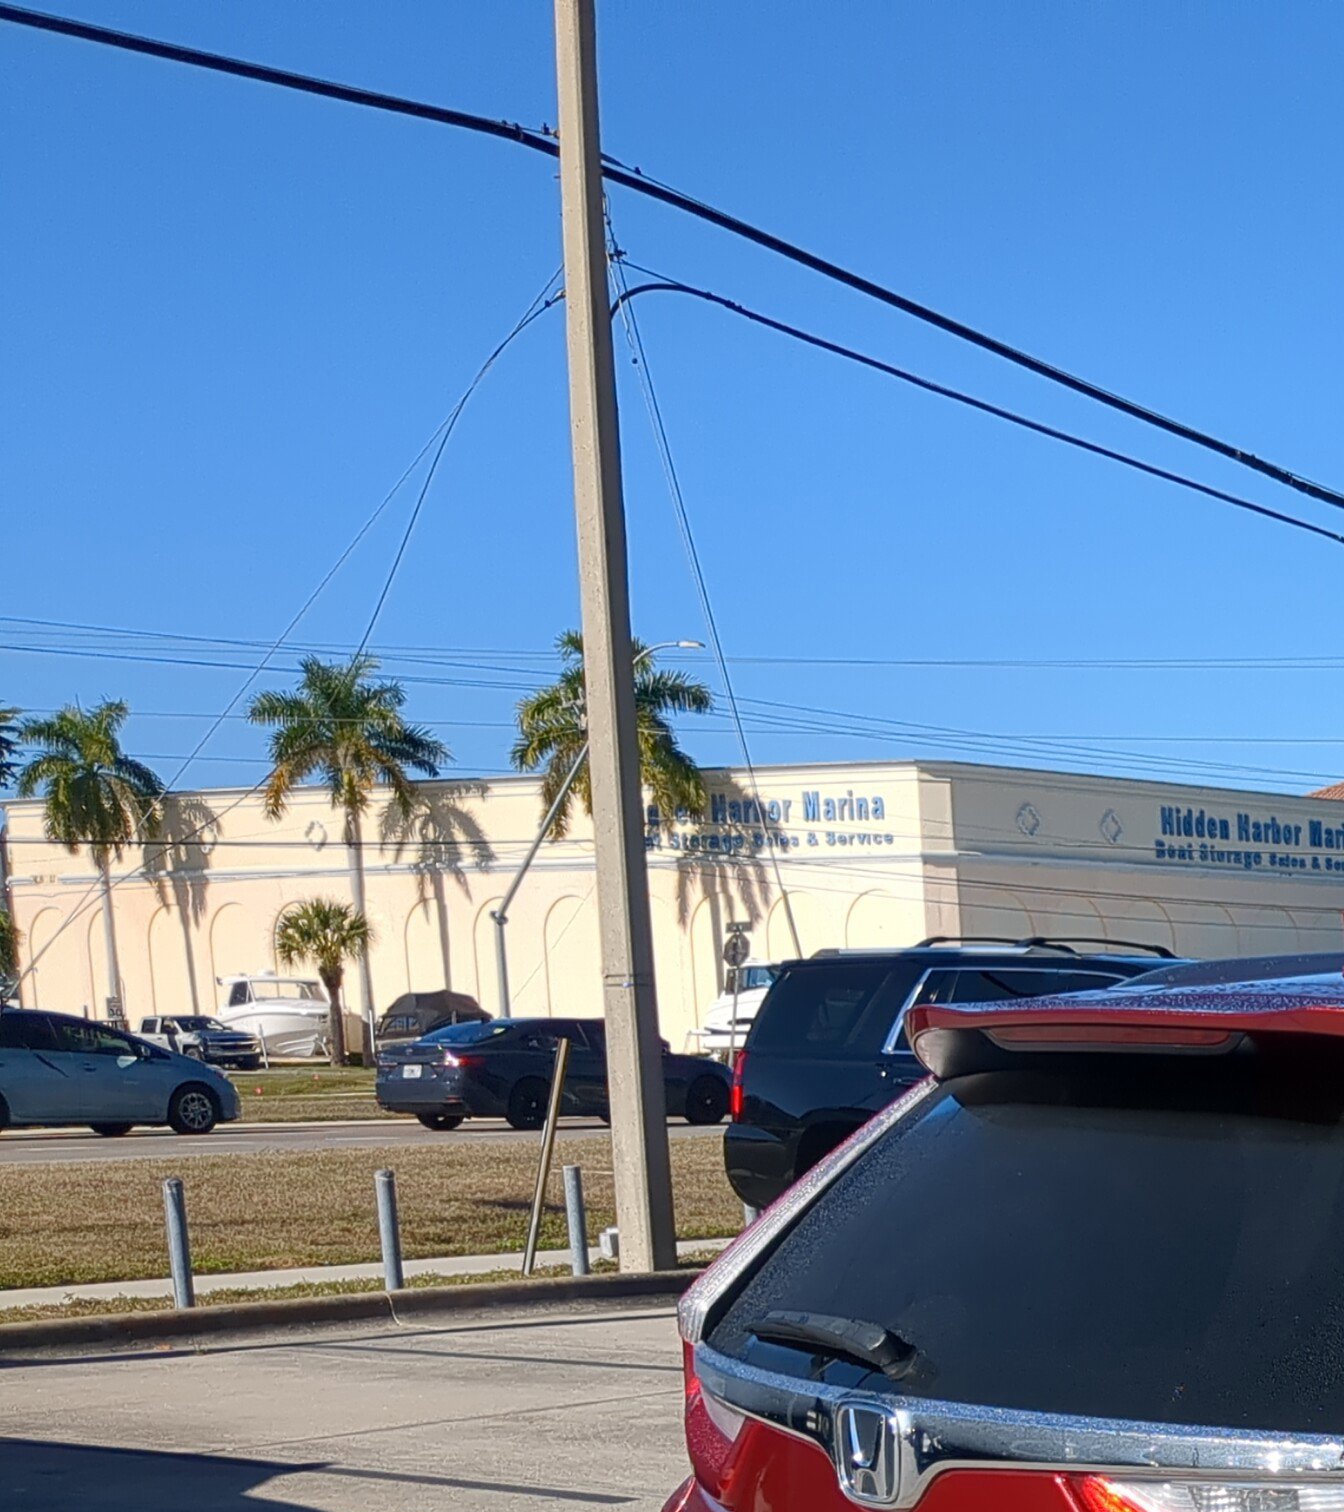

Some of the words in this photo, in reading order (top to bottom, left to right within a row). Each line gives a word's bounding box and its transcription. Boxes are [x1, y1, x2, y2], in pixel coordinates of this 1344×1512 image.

[802, 789, 885, 822] Marina
[825, 831, 894, 847] Service
[1160, 805, 1230, 841] Hidden
[1237, 812, 1302, 846] Harbor
